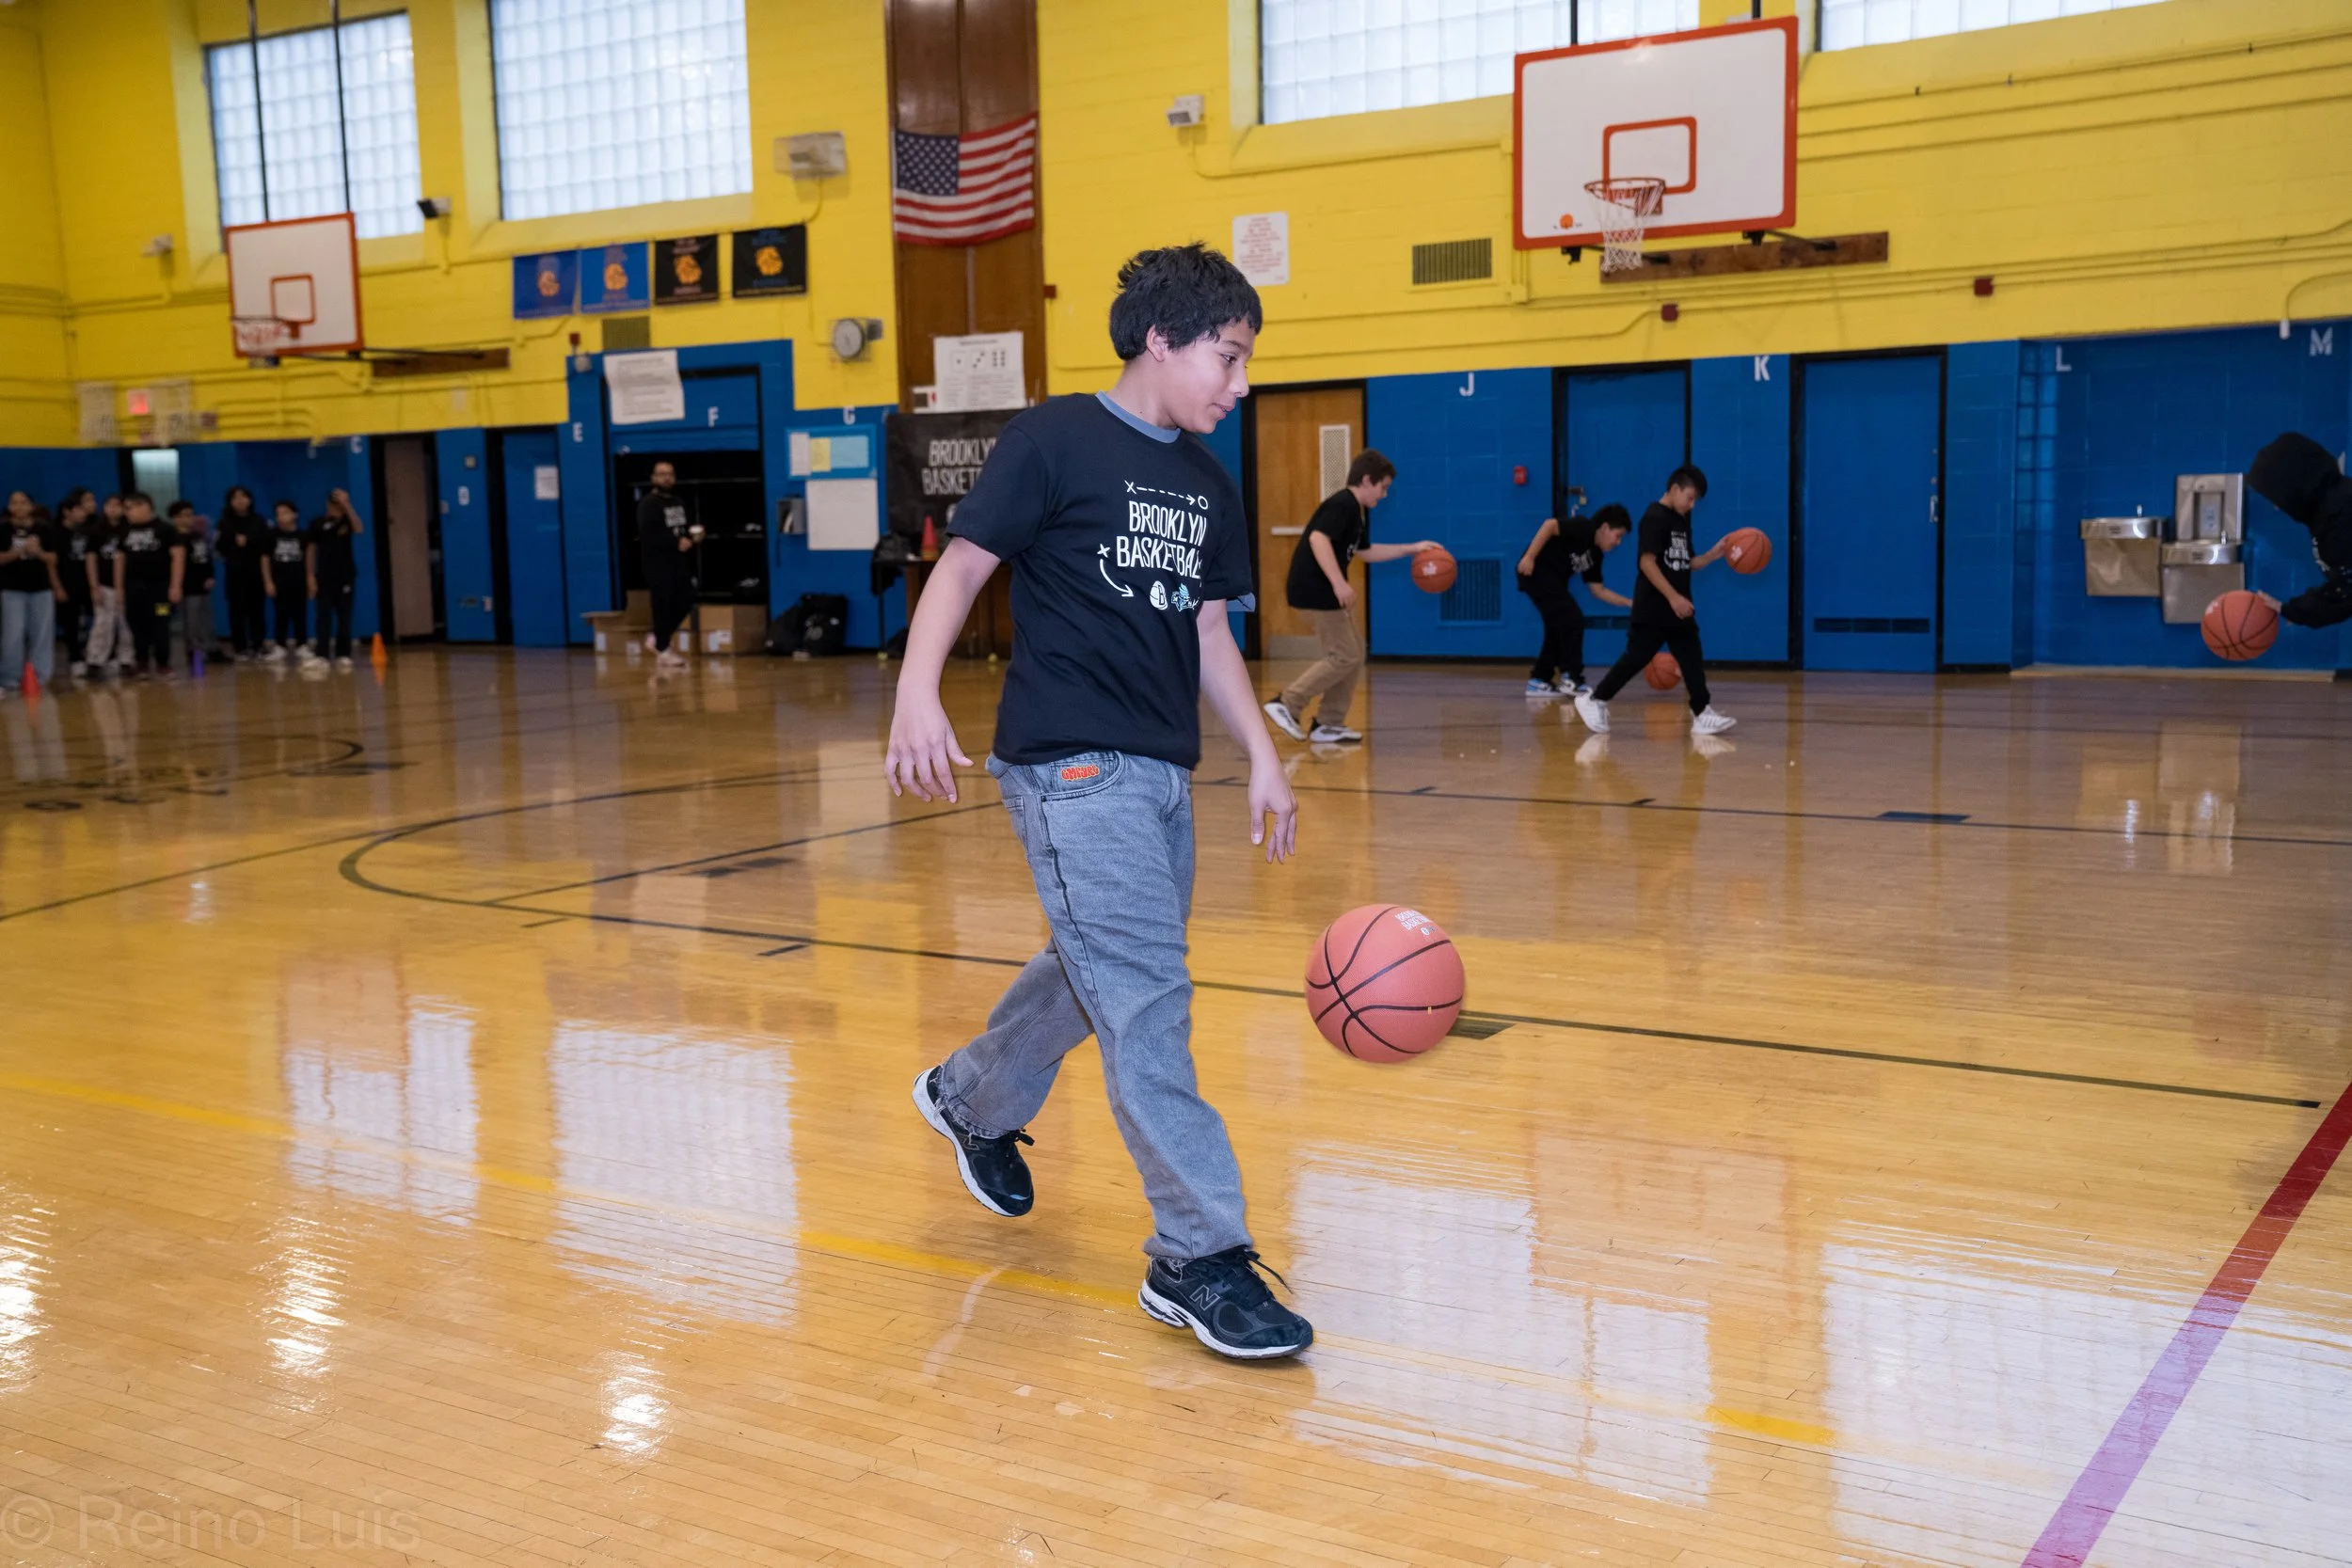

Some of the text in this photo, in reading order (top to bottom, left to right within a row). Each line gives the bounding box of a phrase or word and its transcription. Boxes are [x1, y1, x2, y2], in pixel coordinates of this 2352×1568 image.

[2310, 327, 2333, 356] M
[1755, 355, 1770, 381] K
[2056, 345, 2072, 372] L
[1459, 372, 1474, 396] J
[707, 406, 719, 427] F
[573, 421, 583, 442] E
[929, 437, 996, 467] BROOKLY
[922, 467, 982, 495] BASKET
[1129, 500, 1207, 546] BROOKLYN
[1116, 535, 1201, 579] BASKETBAL
[1189, 1284, 1221, 1311] N
